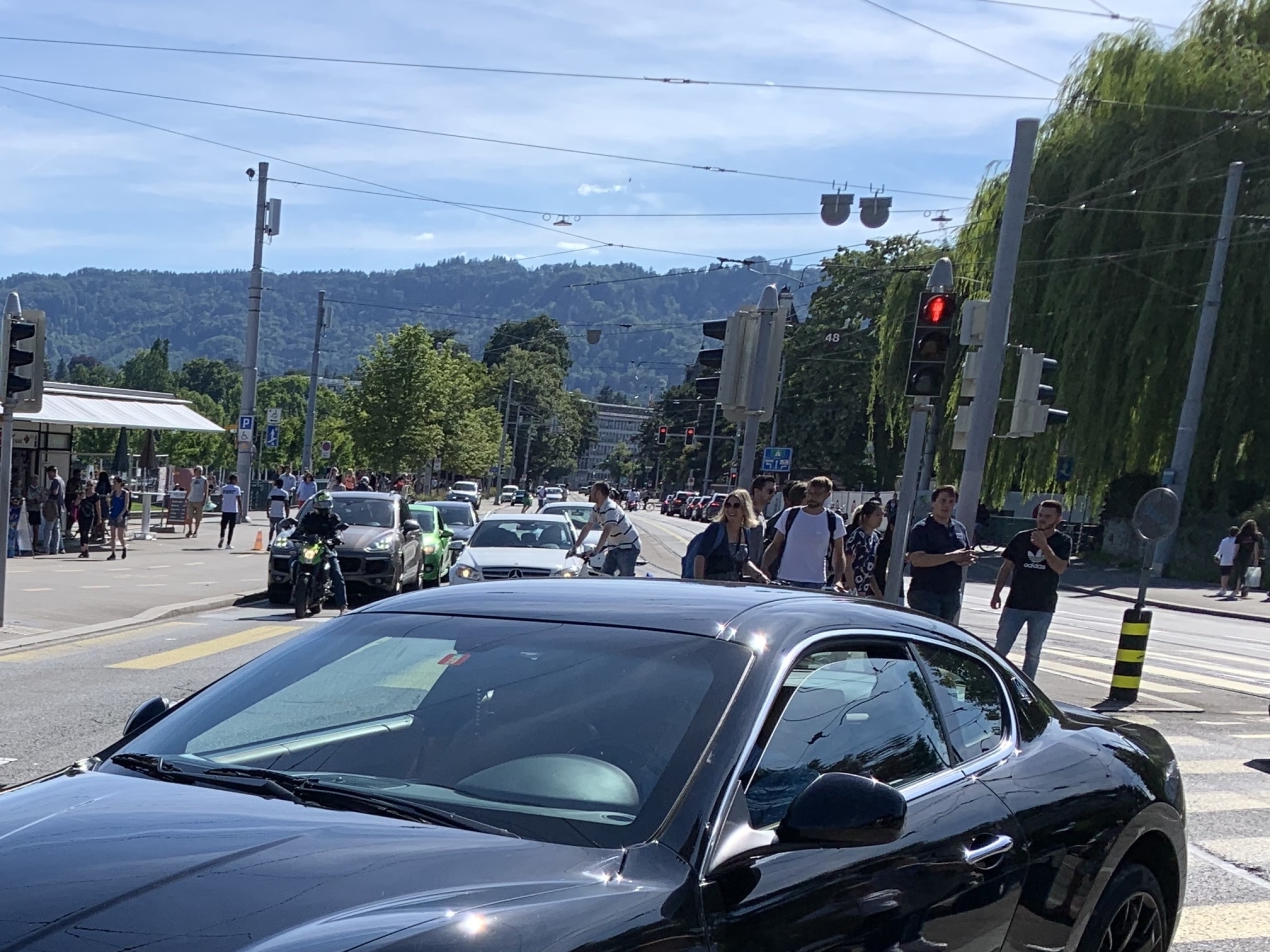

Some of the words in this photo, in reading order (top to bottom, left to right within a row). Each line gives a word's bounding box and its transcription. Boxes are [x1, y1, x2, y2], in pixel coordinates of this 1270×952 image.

[825, 333, 840, 343] 48
[242, 418, 250, 428] P
[1023, 562, 1046, 570] adidas
